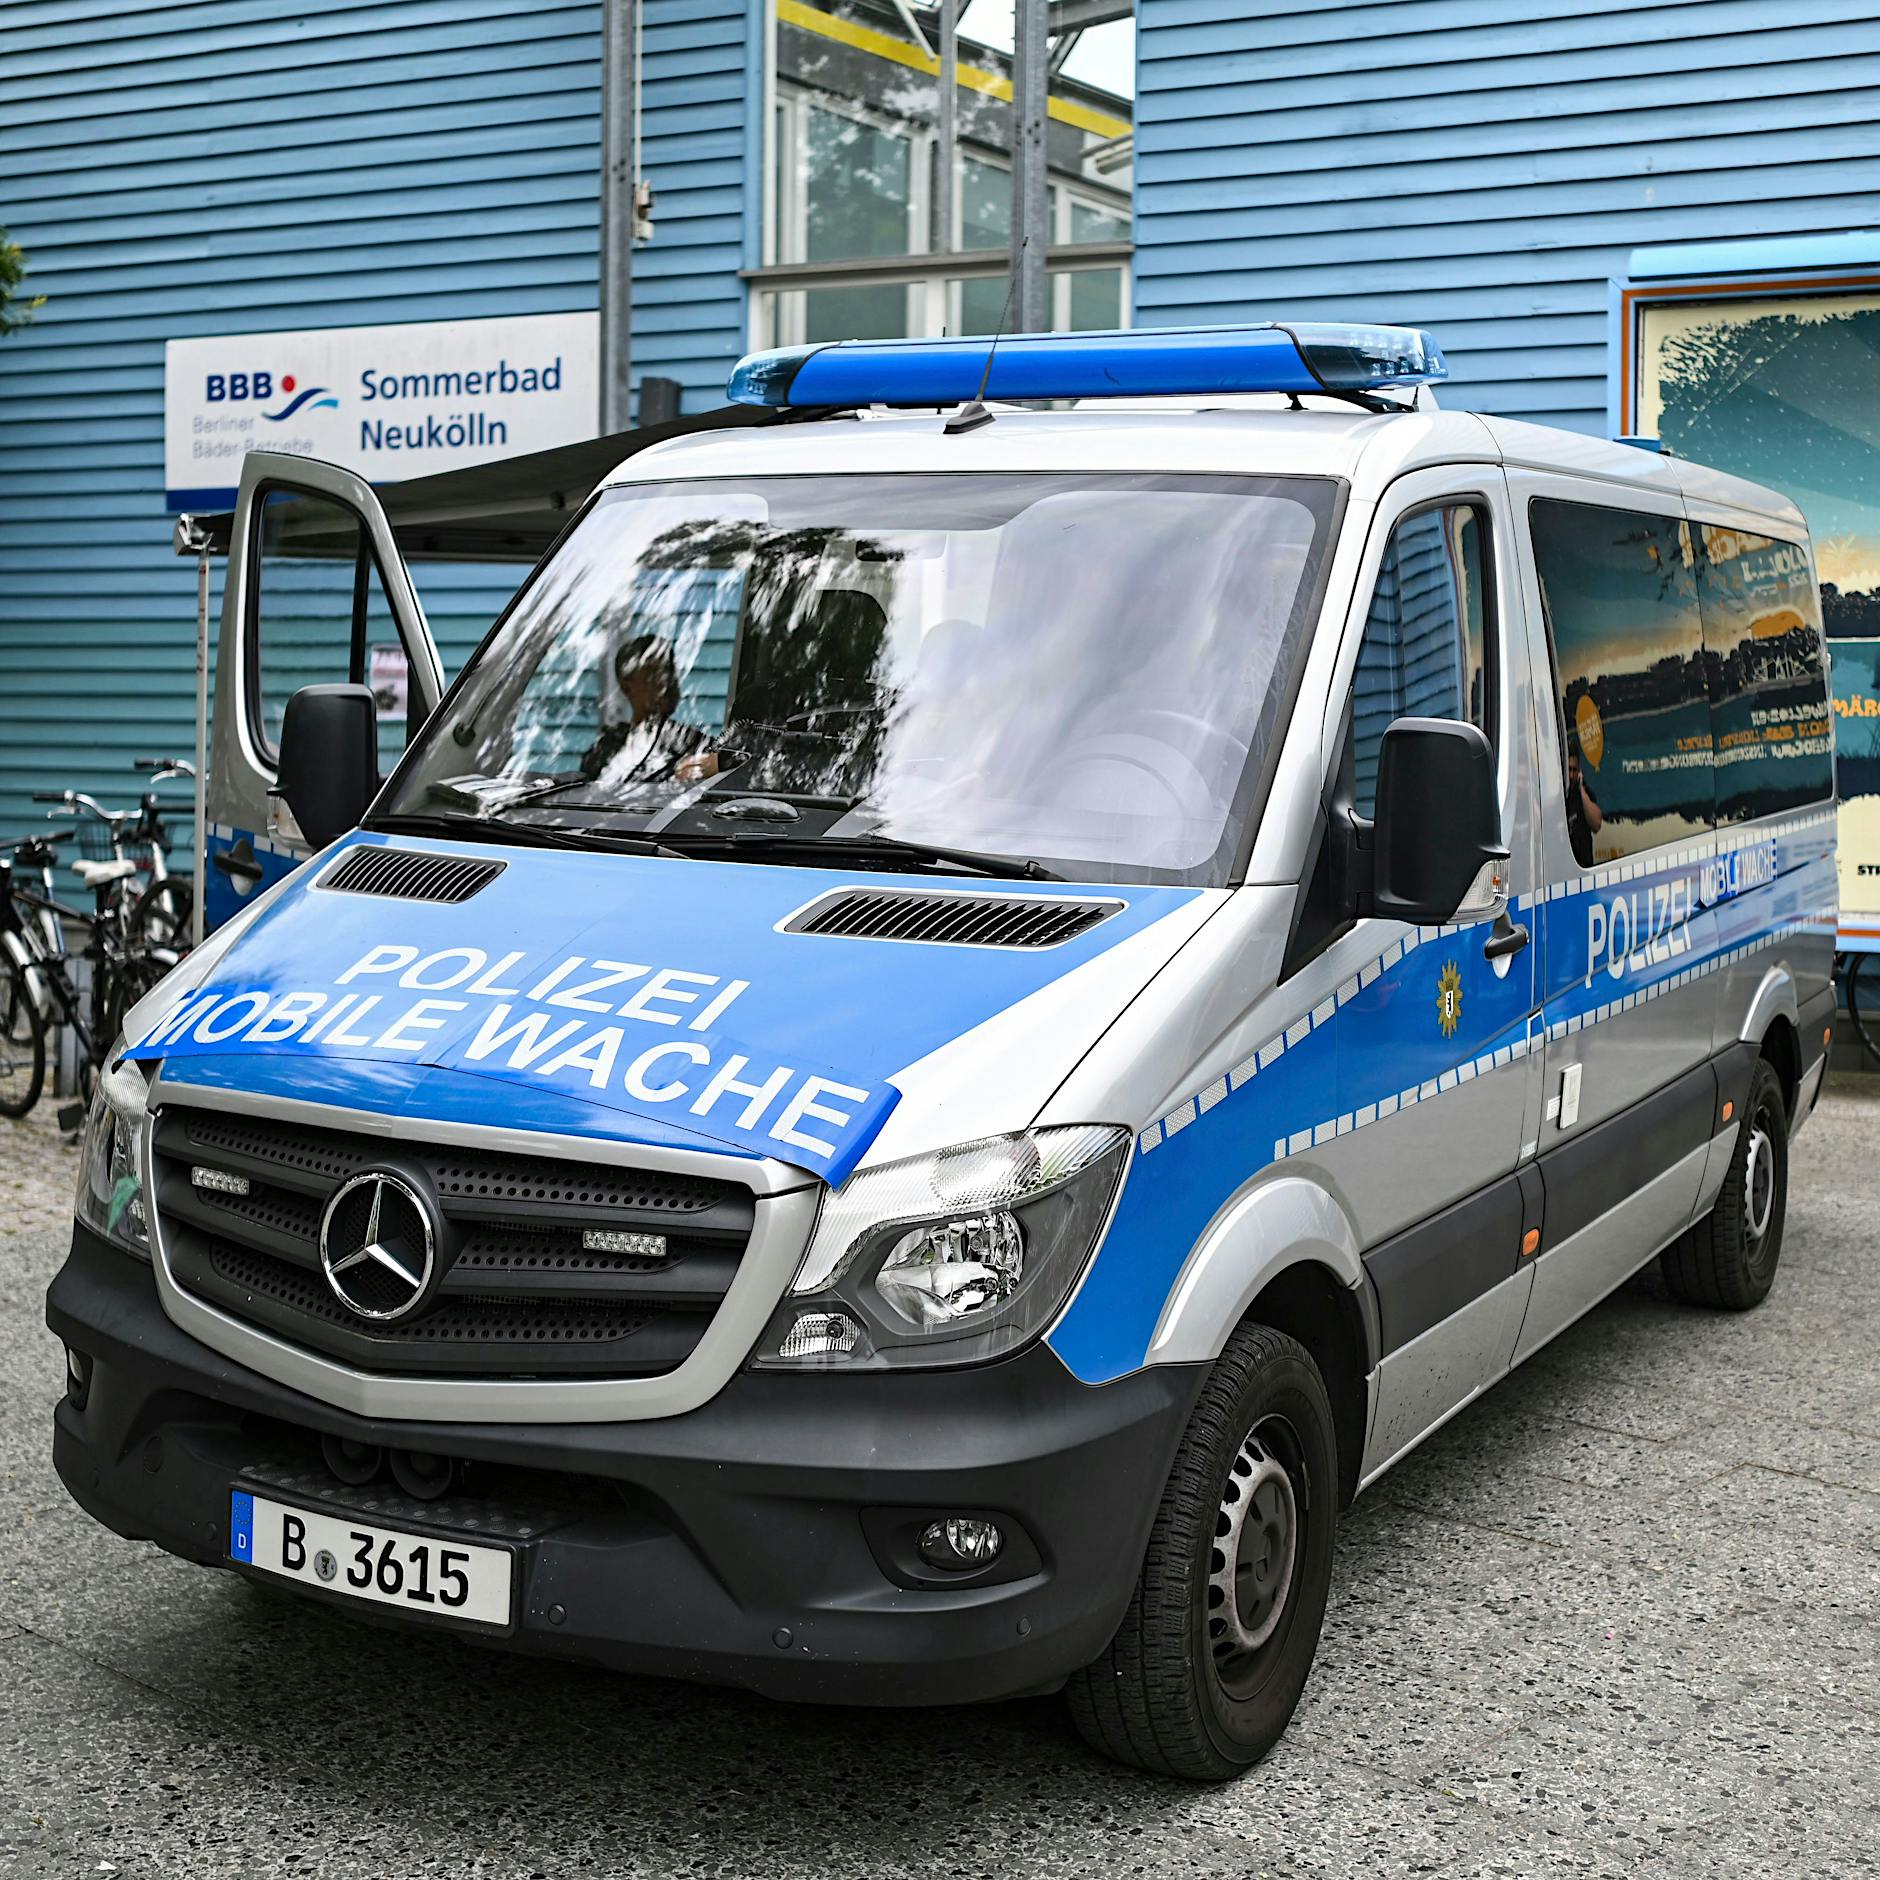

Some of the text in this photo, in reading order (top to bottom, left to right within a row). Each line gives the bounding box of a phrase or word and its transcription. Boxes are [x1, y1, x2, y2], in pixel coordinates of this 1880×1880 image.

[206, 372, 272, 402] BBB
[361, 357, 562, 401] Sommerbad
[193, 415, 254, 434] Berliner
[361, 413, 507, 451] Neukölln
[1832, 694, 1880, 718] MÄR
[1585, 876, 1692, 989] POLIZEI
[334, 944, 751, 1031] POLIZEI
[143, 991, 870, 1159] MOBILE WACHE
[237, 1533, 247, 1549] D
[281, 1512, 307, 1571] B
[346, 1531, 470, 1607] 3615
